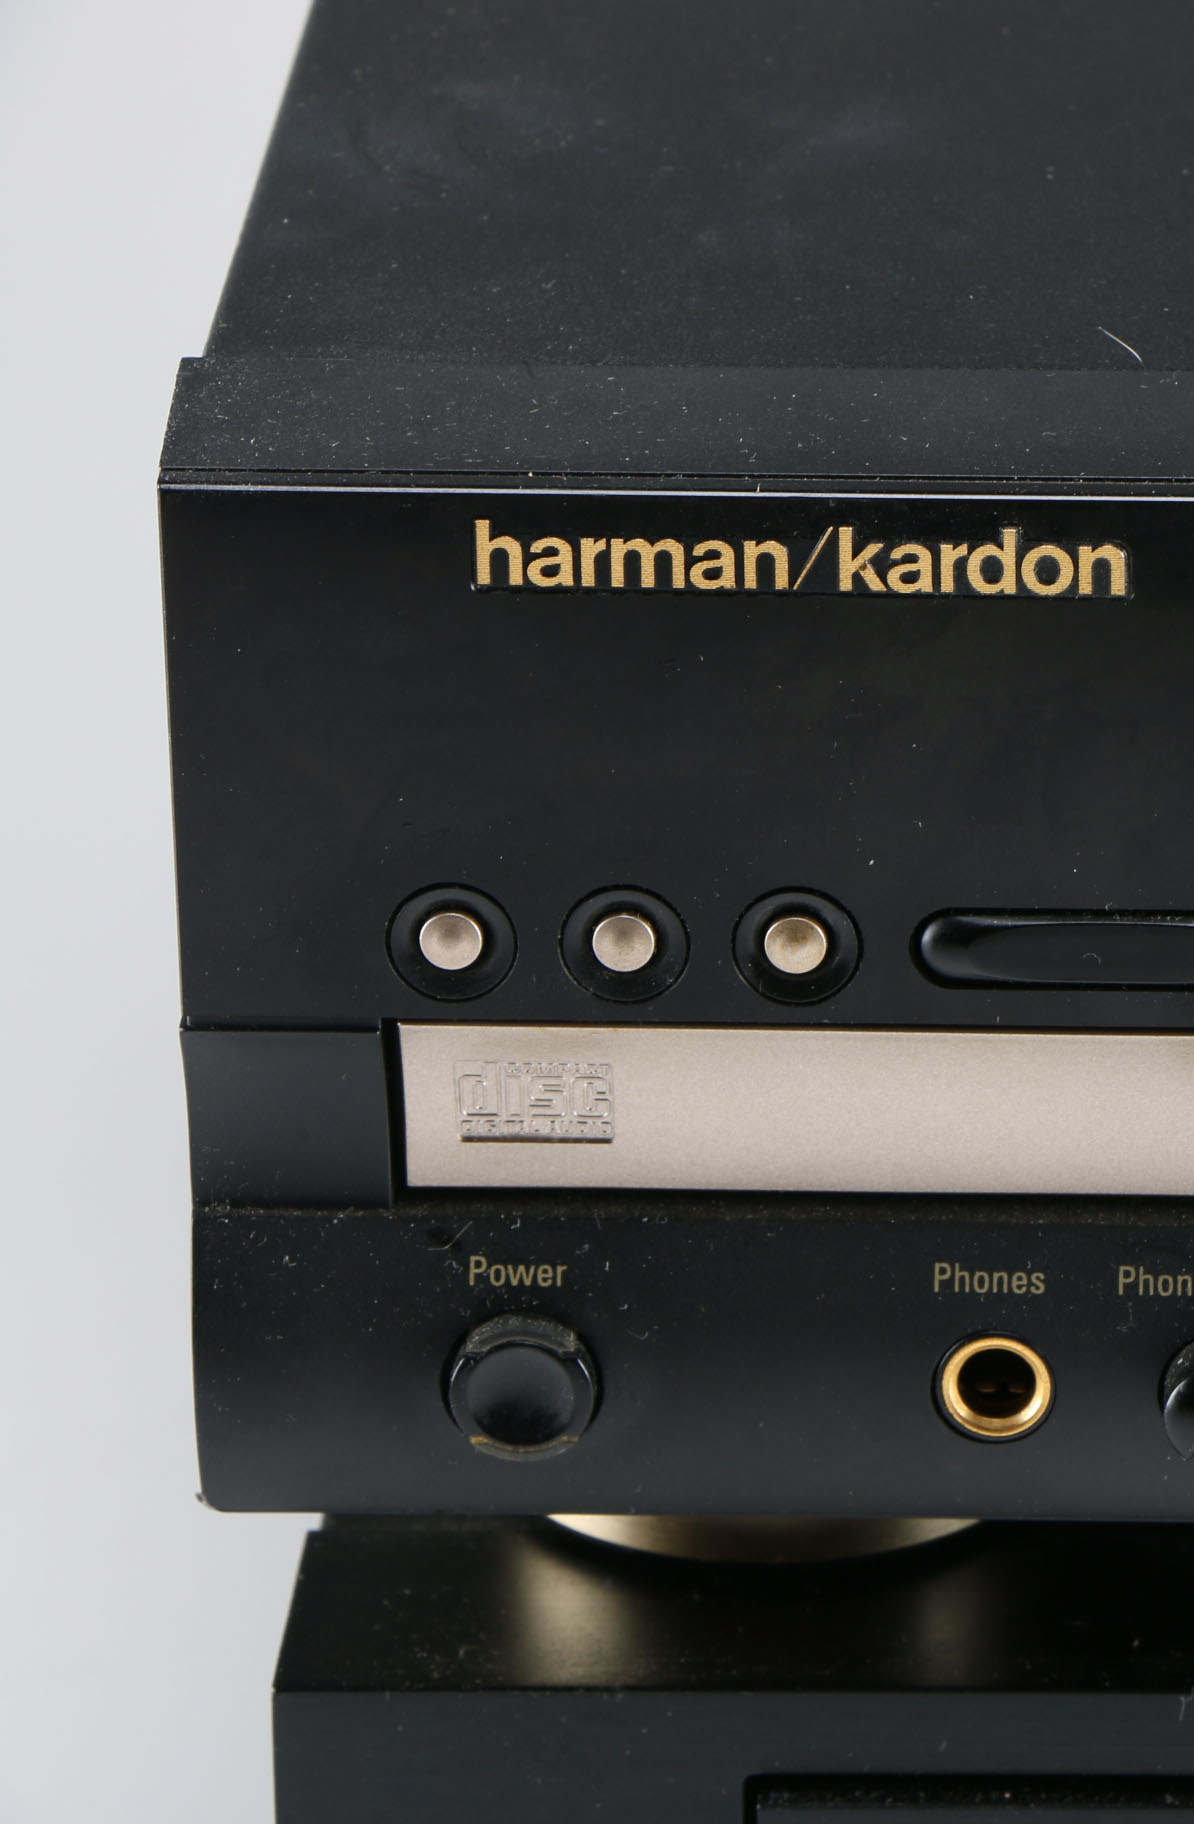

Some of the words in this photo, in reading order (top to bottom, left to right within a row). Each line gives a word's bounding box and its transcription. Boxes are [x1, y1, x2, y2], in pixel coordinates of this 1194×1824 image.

[474, 518, 1128, 596] harman/kardon
[469, 1256, 568, 1287] Power
[933, 1262, 1046, 1295] Phones
